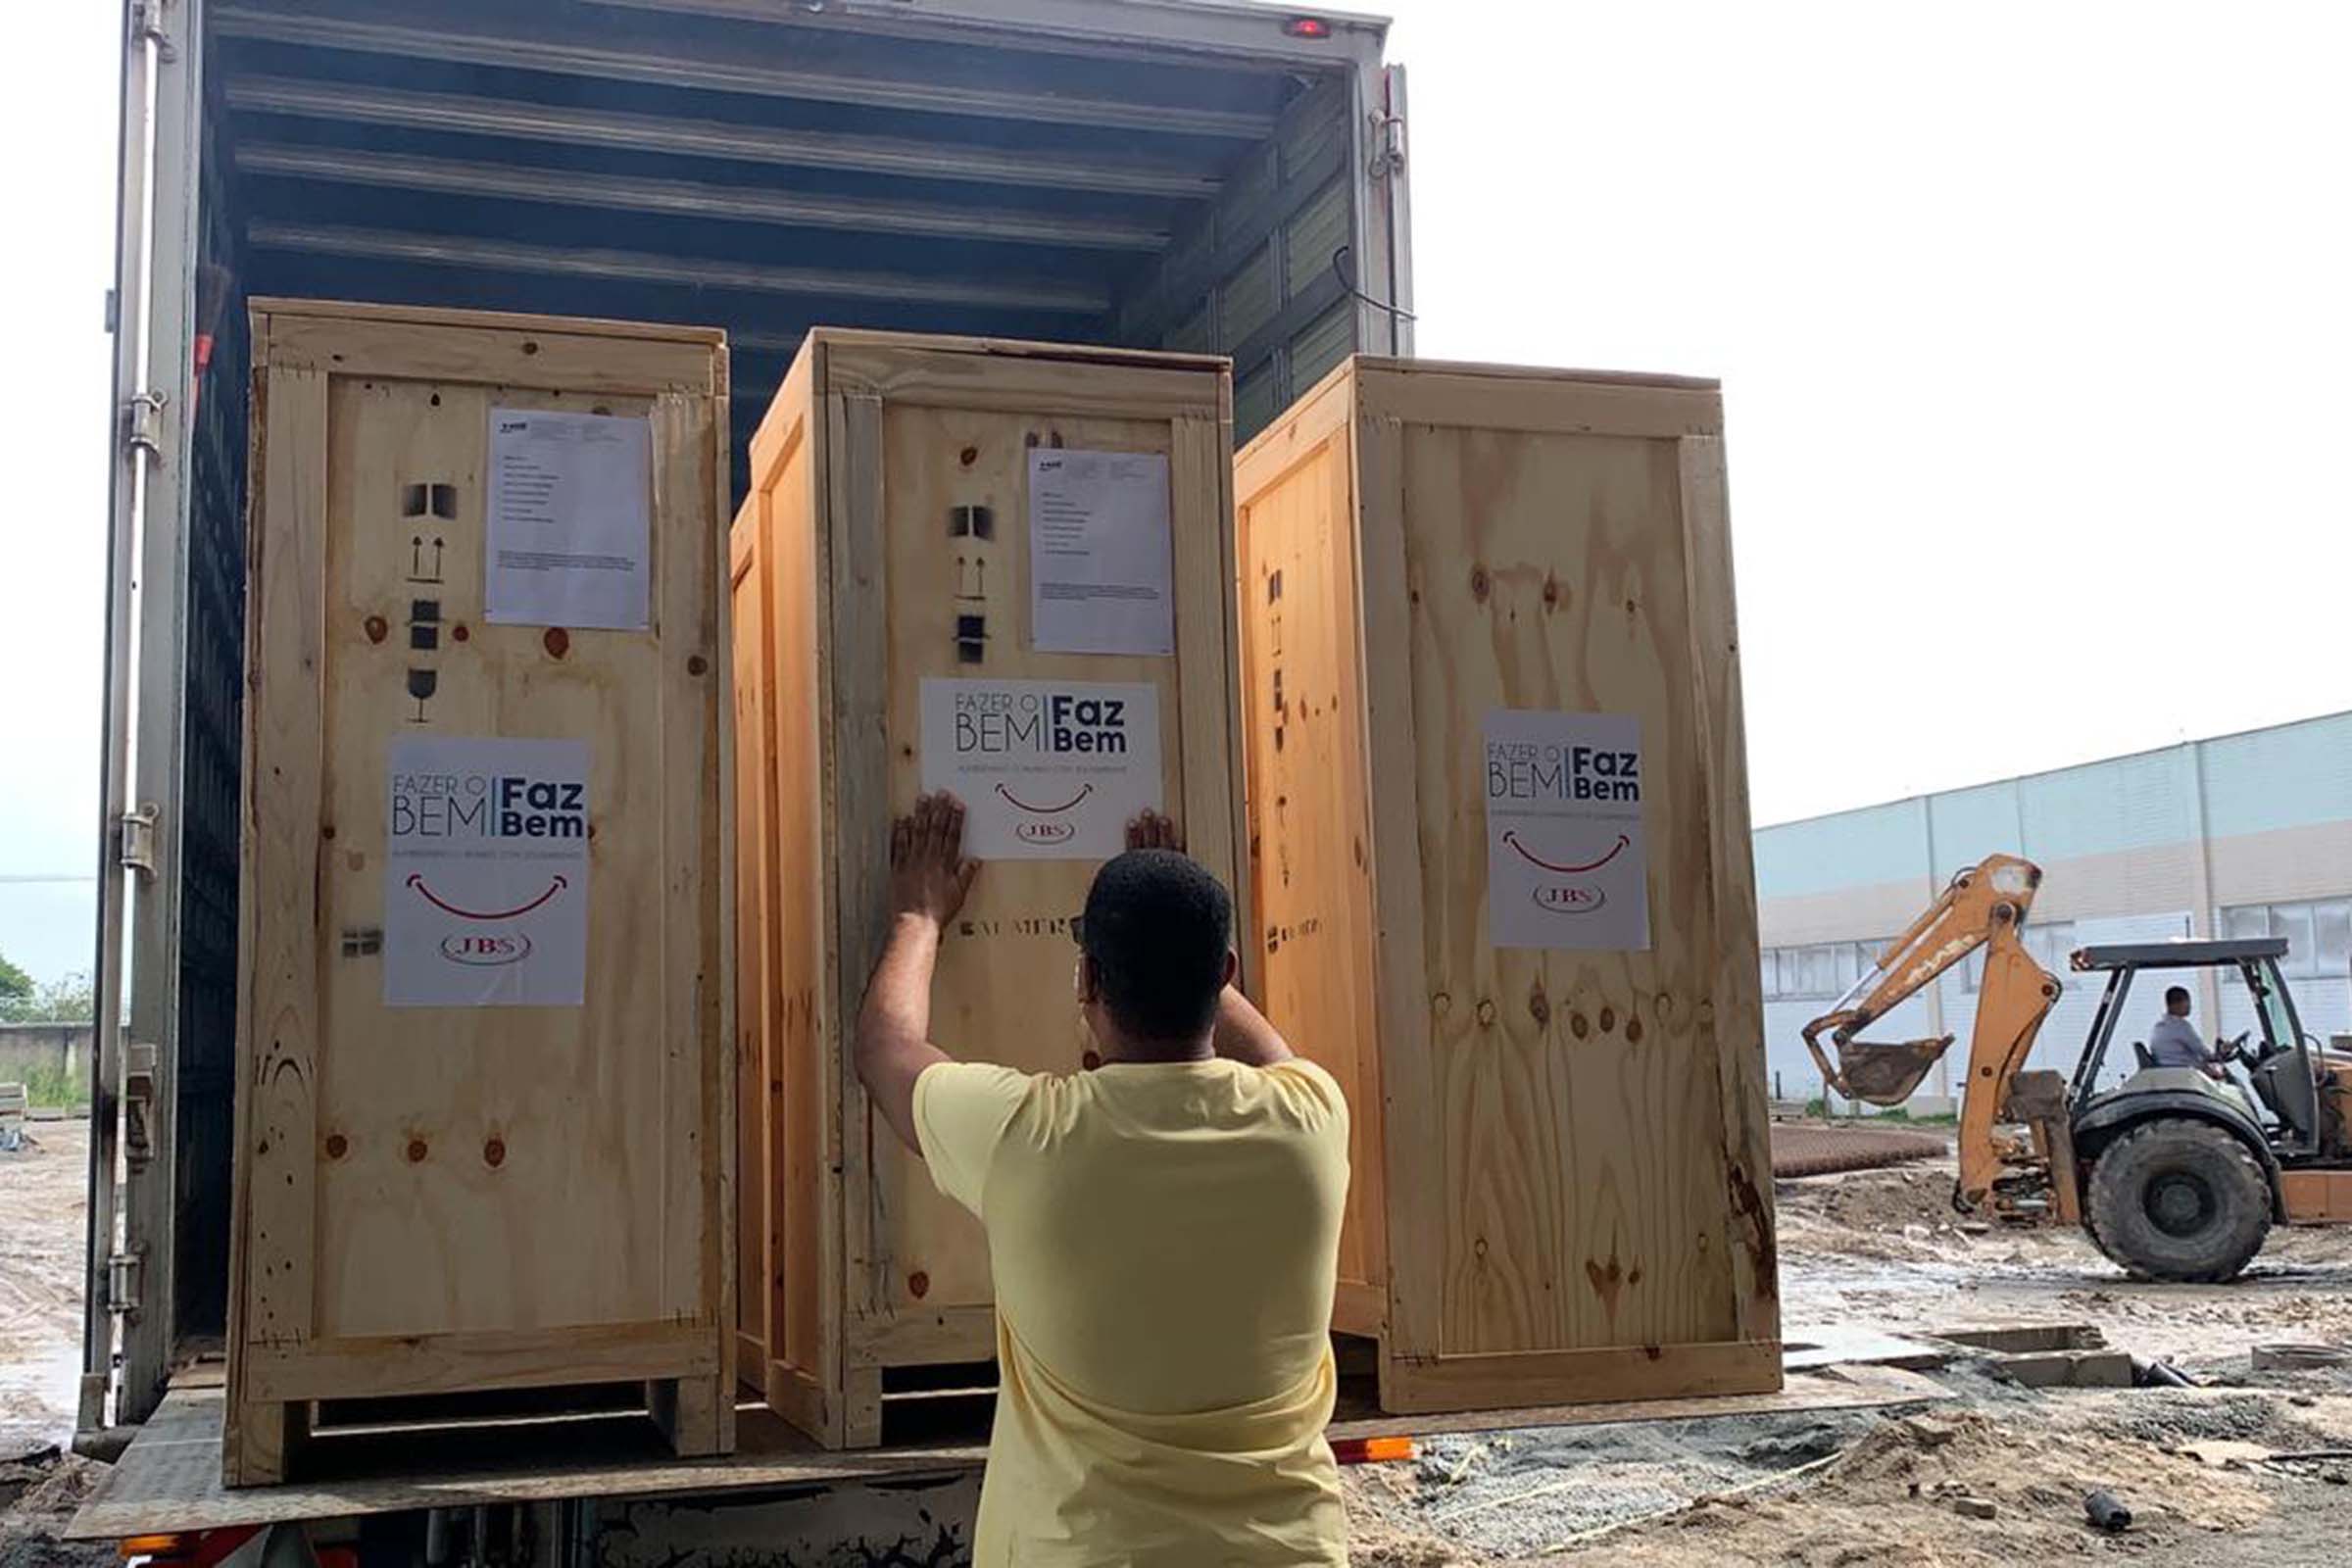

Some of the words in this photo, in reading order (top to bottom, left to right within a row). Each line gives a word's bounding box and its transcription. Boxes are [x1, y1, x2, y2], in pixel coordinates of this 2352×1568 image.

[955, 692, 1013, 712] FAZER
[1019, 693, 1038, 712] O
[1053, 696, 1125, 727] Faz
[956, 712, 1041, 753] BEM
[1054, 727, 1127, 754] Bem
[1487, 743, 1540, 762] FAZER
[1544, 745, 1561, 763] O
[1573, 747, 1639, 777] Faz
[393, 774, 458, 796] FAZER
[465, 775, 487, 796] O
[501, 777, 583, 810] Faz
[1488, 761, 1562, 800] BEM
[1574, 777, 1640, 802] Bem
[393, 795, 486, 836] BEM
[501, 811, 583, 837] Bem
[1025, 824, 1065, 837] JBS
[1545, 888, 1592, 904] JBS
[456, 937, 515, 955] JBS
